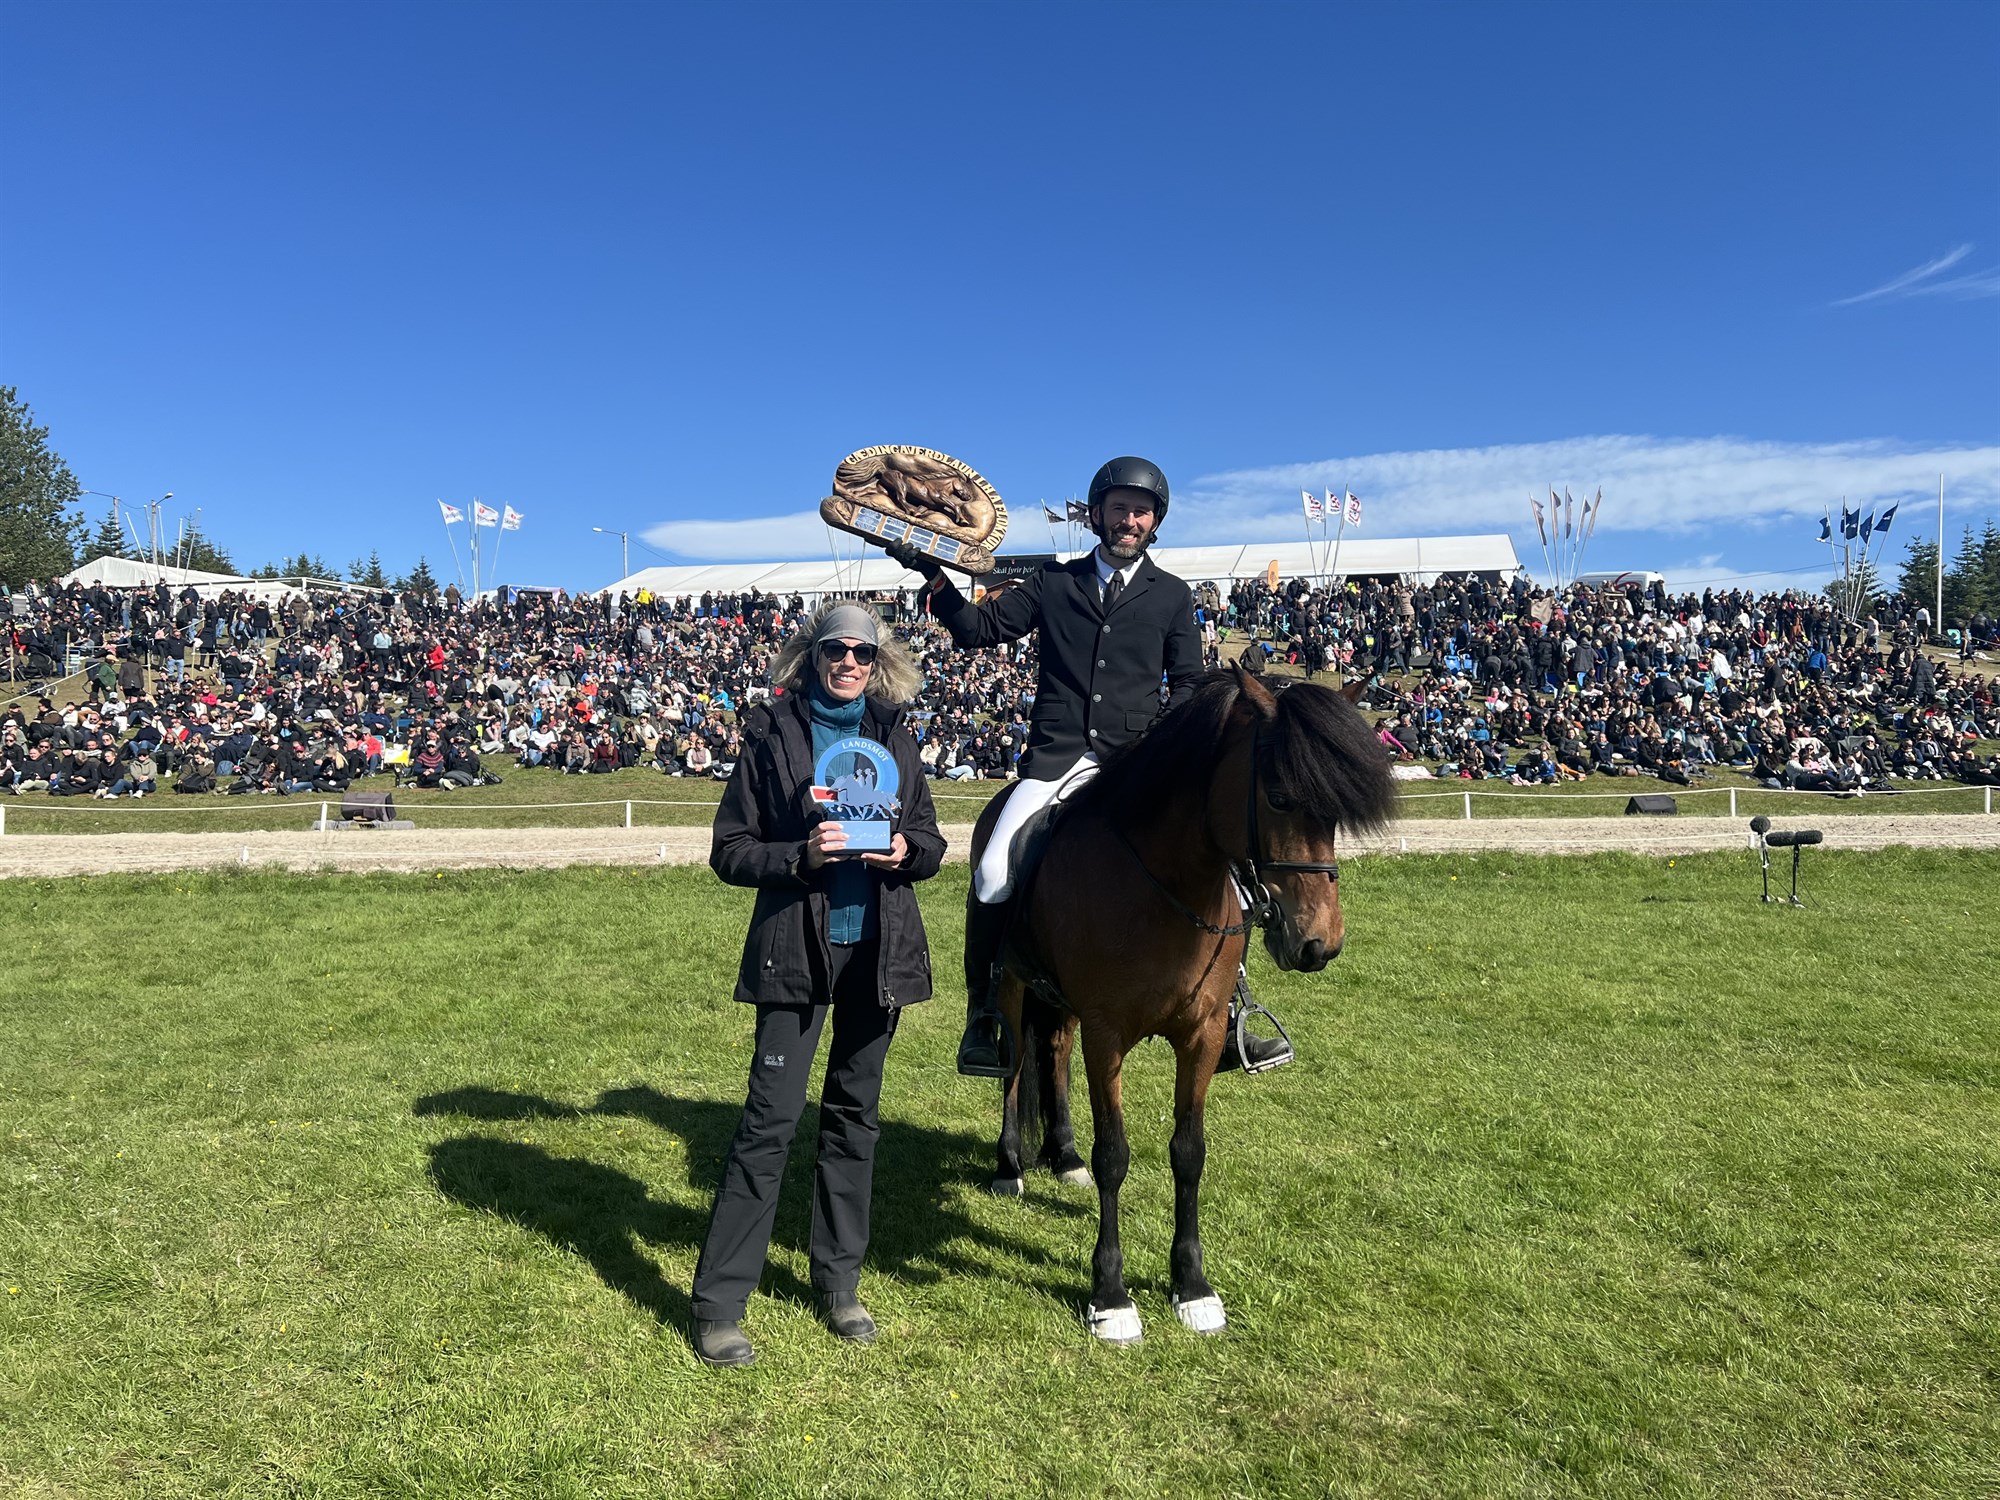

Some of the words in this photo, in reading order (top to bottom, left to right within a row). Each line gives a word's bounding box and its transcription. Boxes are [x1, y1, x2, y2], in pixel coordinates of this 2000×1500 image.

[974, 476, 996, 494] LH
[991, 495, 1003, 505] A
[980, 503, 1008, 551] FLOKKUR
